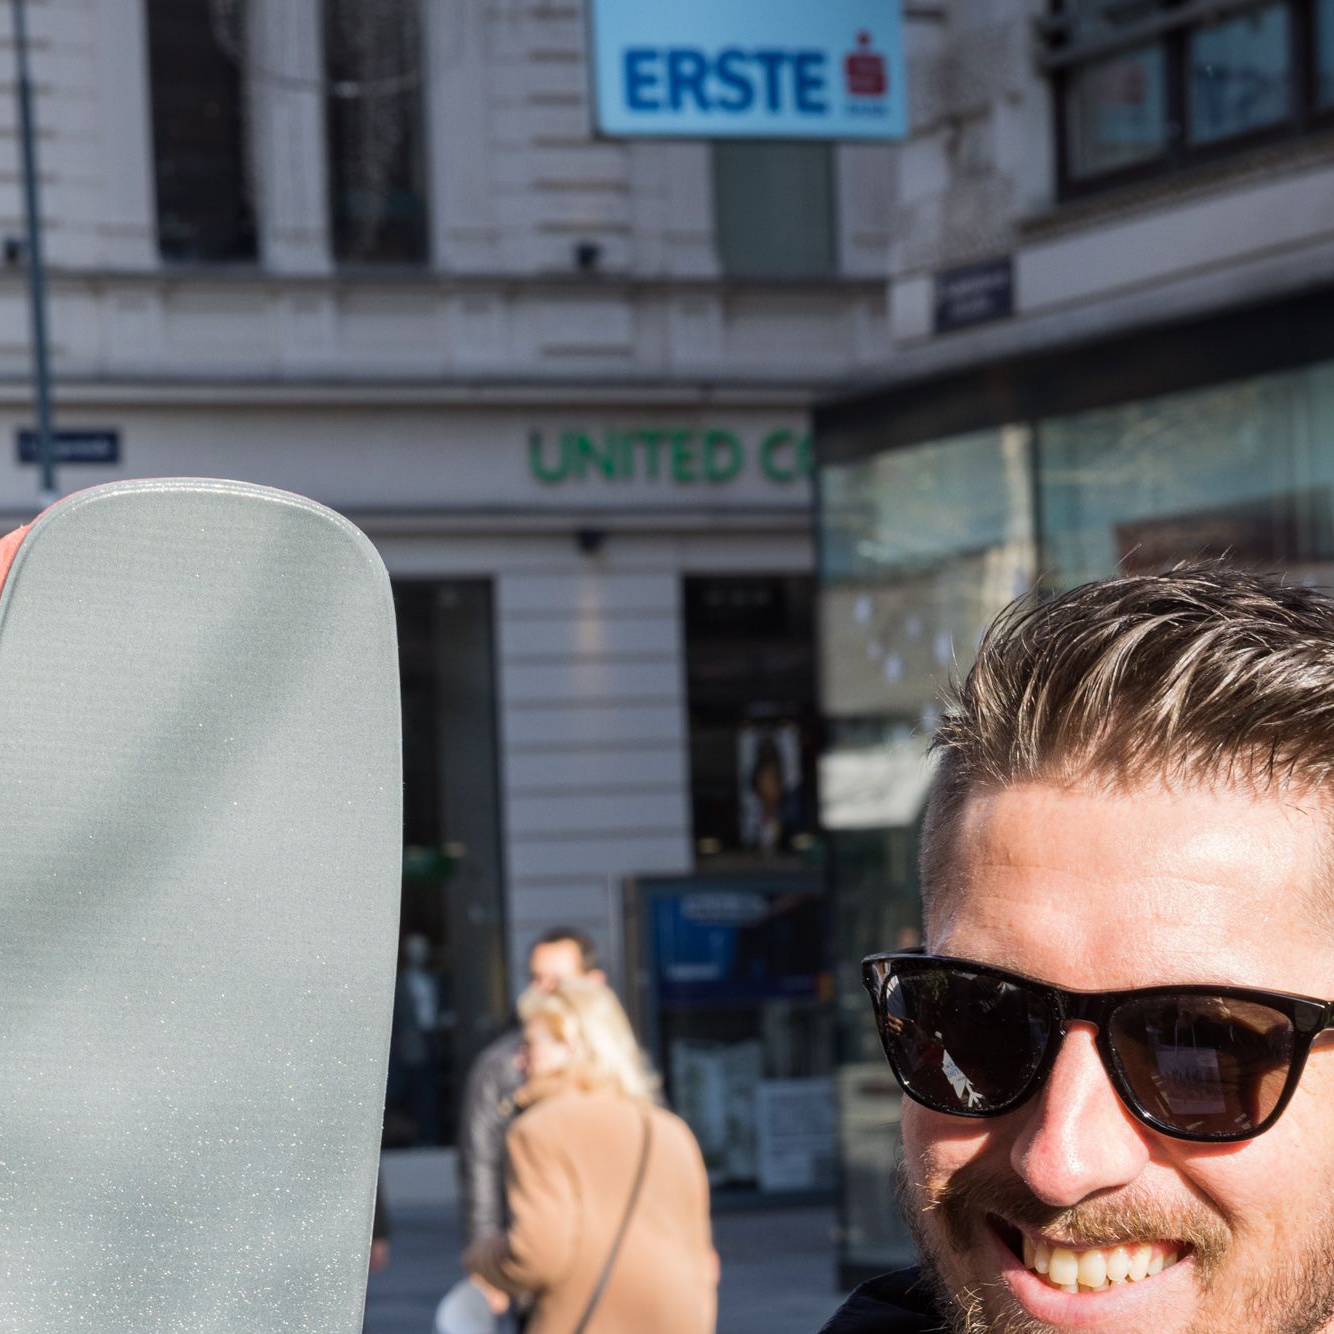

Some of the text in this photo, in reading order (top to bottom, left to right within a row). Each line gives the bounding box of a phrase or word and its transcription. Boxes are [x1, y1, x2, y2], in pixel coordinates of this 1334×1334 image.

[623, 48, 828, 113] ERSTE
[527, 428, 813, 484] UNITED C
